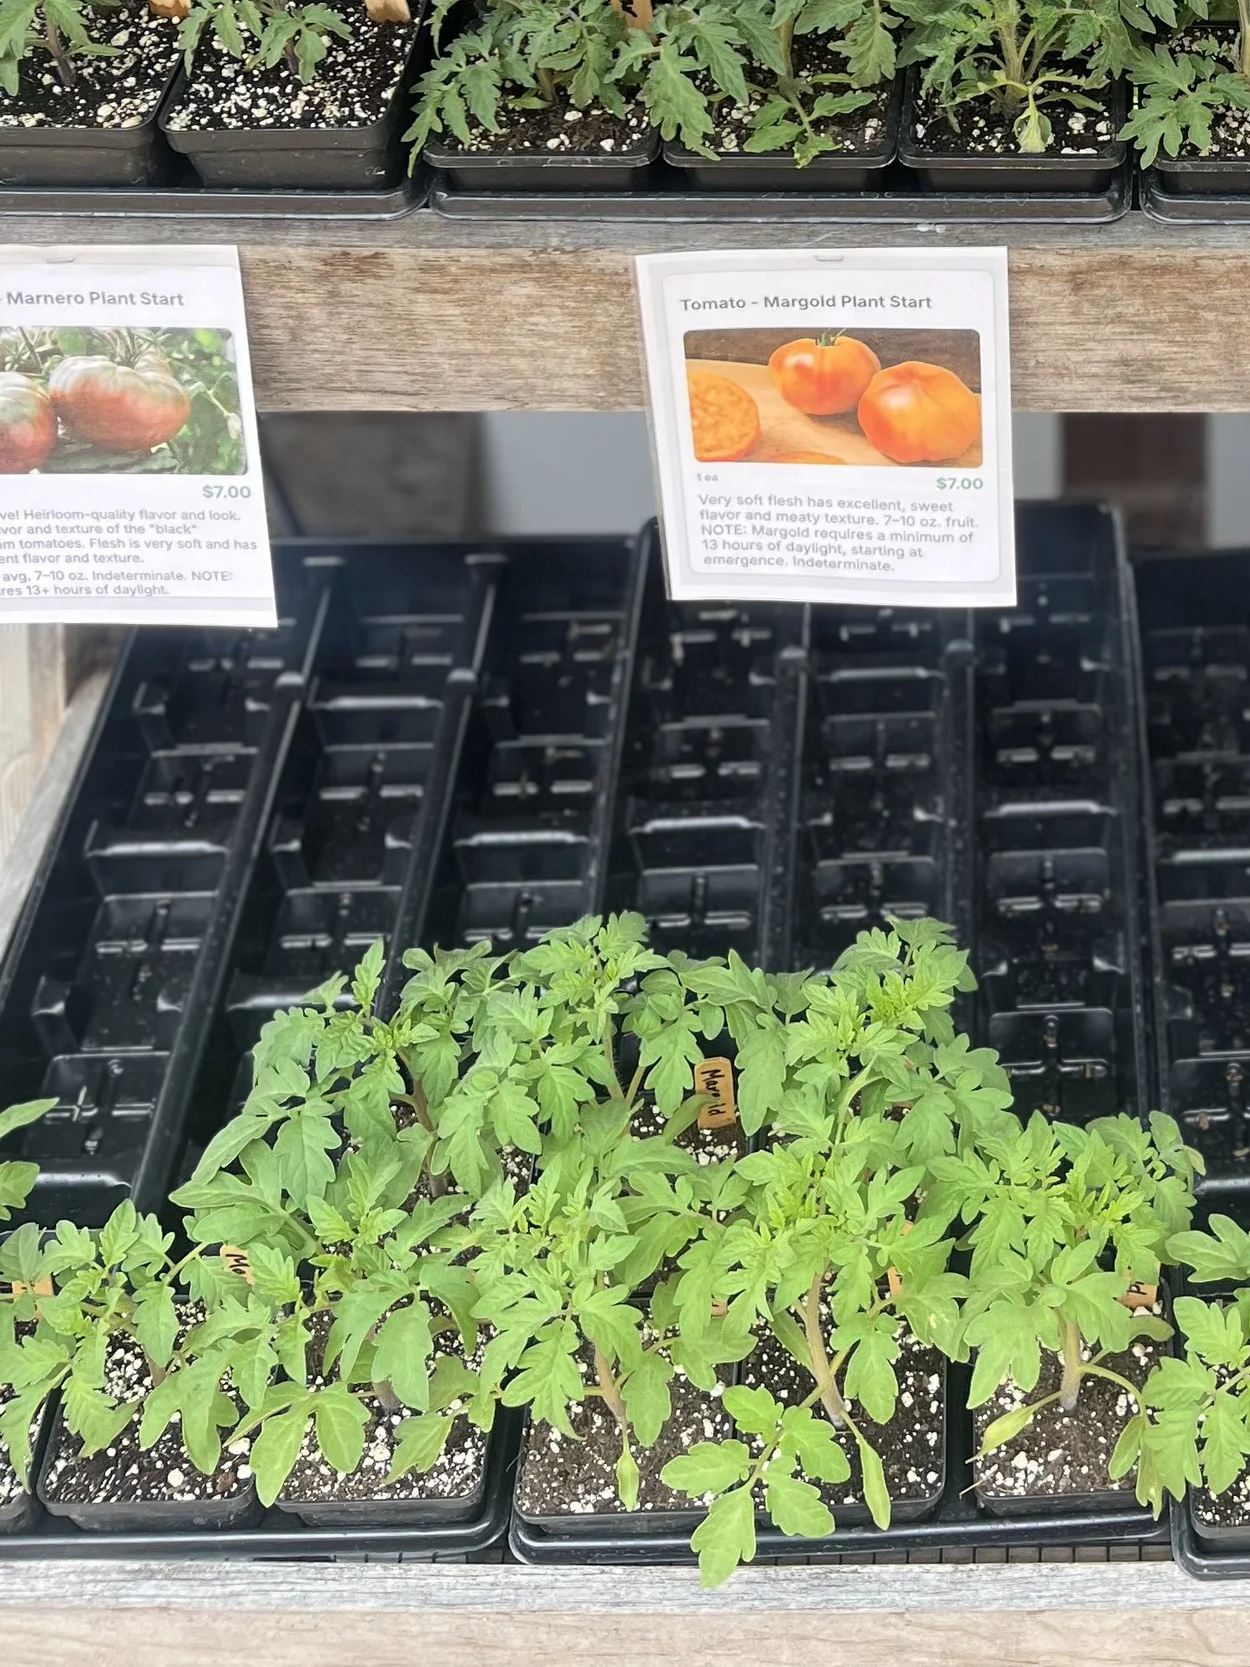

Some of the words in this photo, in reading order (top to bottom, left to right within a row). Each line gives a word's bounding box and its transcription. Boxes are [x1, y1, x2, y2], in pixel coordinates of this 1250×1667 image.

[6, 291, 84, 305] Marnero
[89, 291, 136, 305] Plant
[139, 291, 184, 306] Start
[679, 297, 745, 310] Tomato
[763, 295, 835, 310] Margold
[841, 295, 885, 307] Plant
[890, 295, 931, 308] Start
[936, 476, 983, 490] $7.00
[202, 484, 251, 498] $7.00
[697, 493, 732, 507] Very
[736, 494, 763, 506] soft
[767, 495, 803, 507] flesh
[807, 496, 833, 508] has
[836, 498, 905, 513] excellent,
[910, 501, 953, 512] sweet
[699, 508, 741, 520] flavor
[744, 510, 771, 521] and
[775, 512, 820, 525] meaty
[824, 512, 879, 525] texture.
[919, 518, 941, 527] oz.
[945, 516, 978, 528] fruit.
[701, 523, 746, 536] NOTE:
[751, 524, 809, 539] Margold
[814, 528, 873, 541] requires
[876, 532, 885, 541] a
[889, 530, 954, 542] minimum
[959, 531, 974, 543] of
[701, 538, 718, 550] 13
[722, 539, 763, 550] hours
[767, 540, 781, 551] of
[785, 541, 846, 556] daylight,
[851, 544, 904, 559] starting
[909, 547, 923, 557] at
[703, 556, 788, 568] emergence.
[792, 556, 895, 571] Indeterminate.
